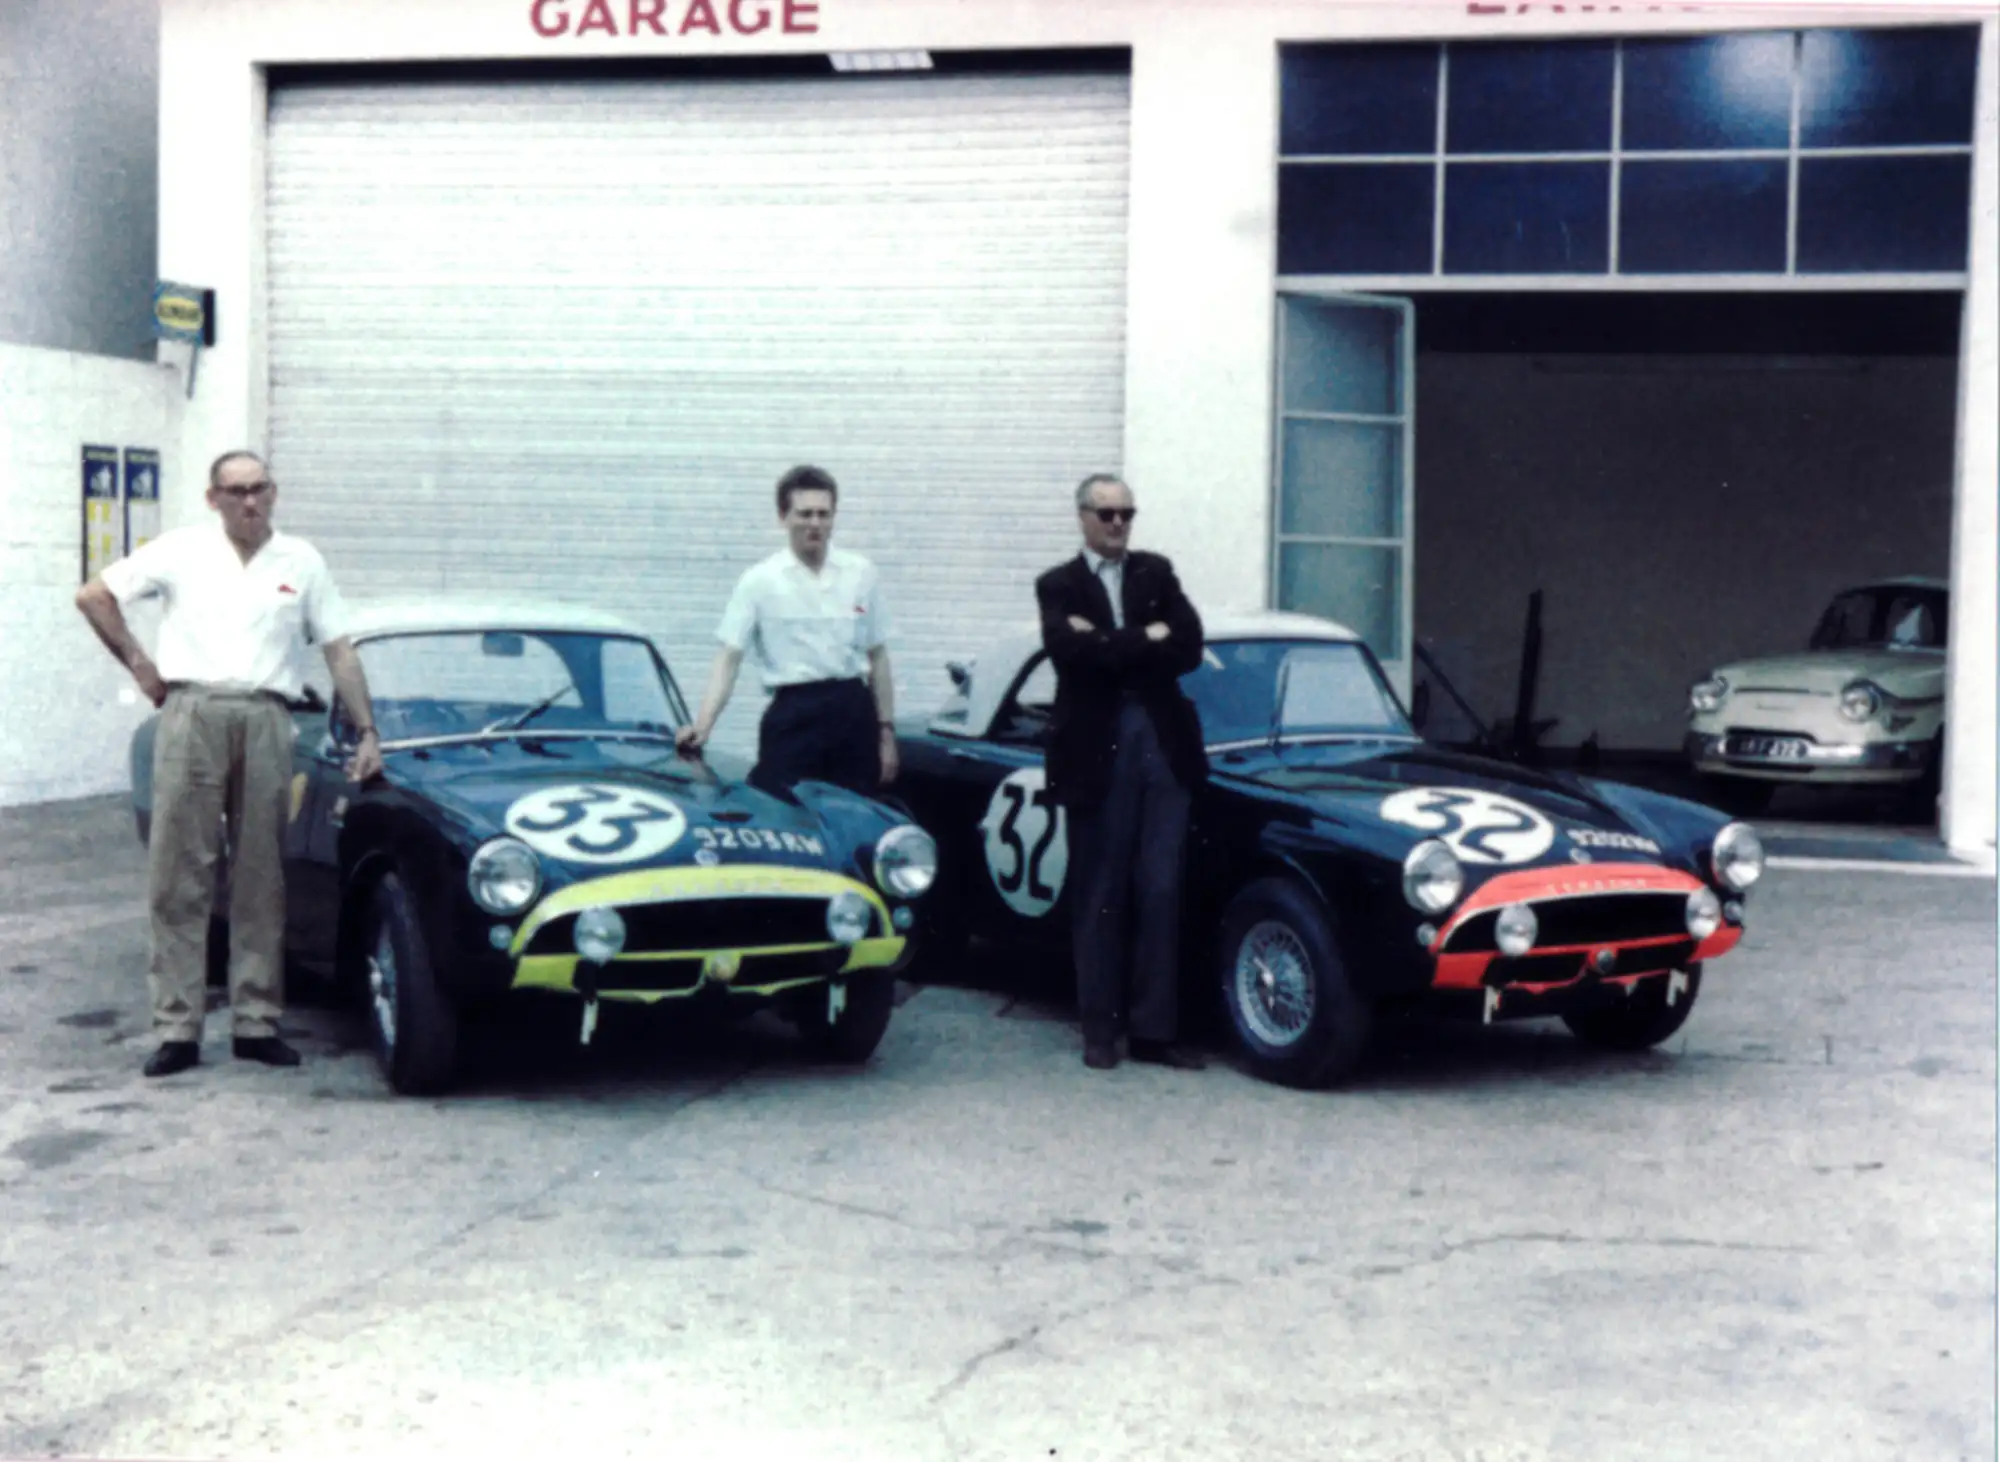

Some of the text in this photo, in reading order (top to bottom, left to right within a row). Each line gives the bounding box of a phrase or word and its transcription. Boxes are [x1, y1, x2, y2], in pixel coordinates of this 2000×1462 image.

[530, 0, 820, 37] GARAGE
[515, 785, 675, 855] 33
[998, 782, 1058, 901] 32
[1402, 790, 1539, 861] 32
